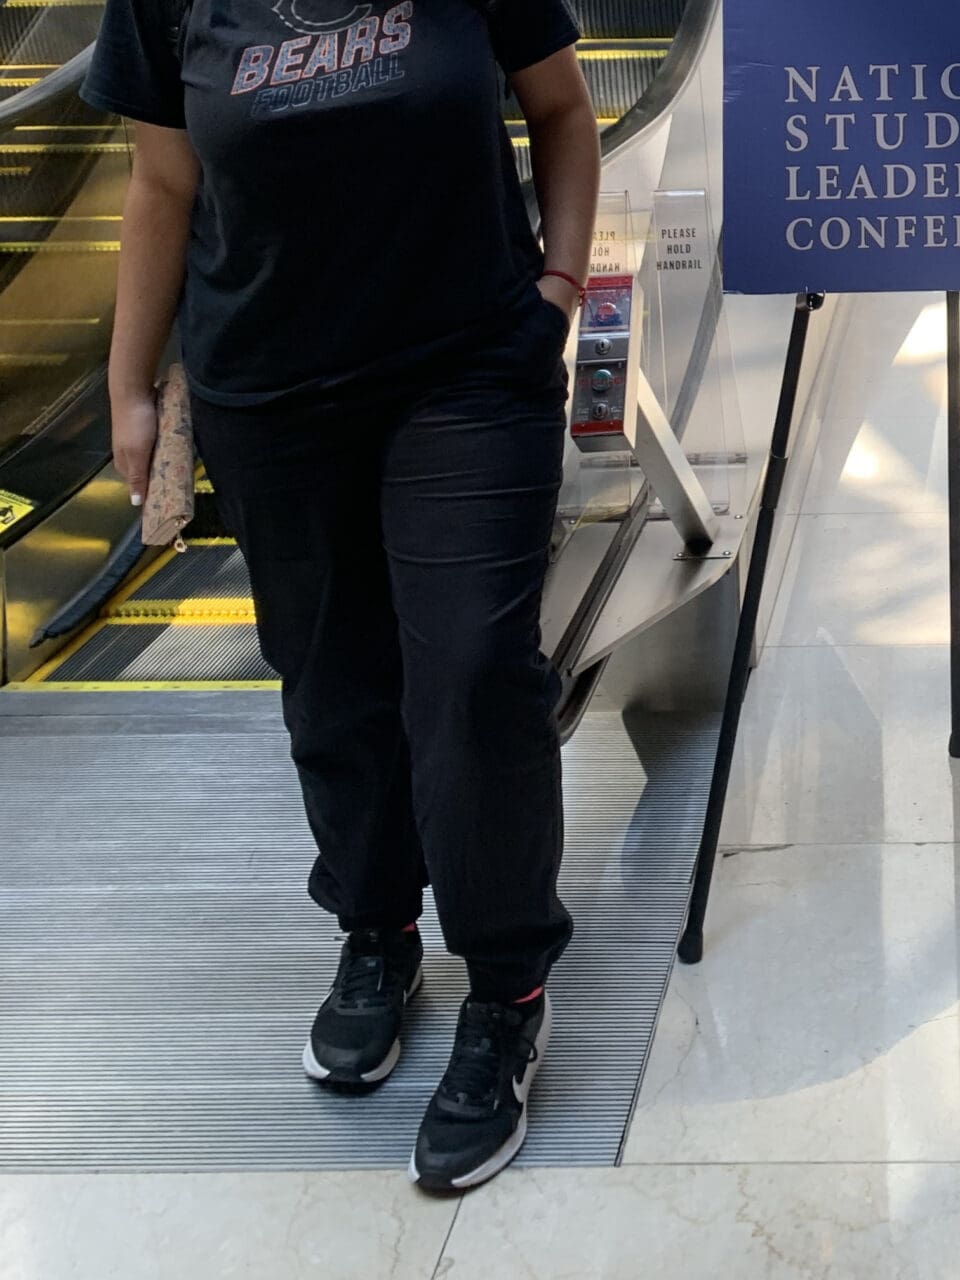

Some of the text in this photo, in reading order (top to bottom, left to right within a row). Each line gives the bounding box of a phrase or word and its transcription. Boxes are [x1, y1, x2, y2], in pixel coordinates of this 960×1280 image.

[230, 0, 413, 95] BEARS
[252, 53, 405, 114] FOOTBALL
[661, 228, 697, 239] PLEASE
[667, 244, 691, 255] HOLD
[656, 260, 703, 270] HANDRAIL
